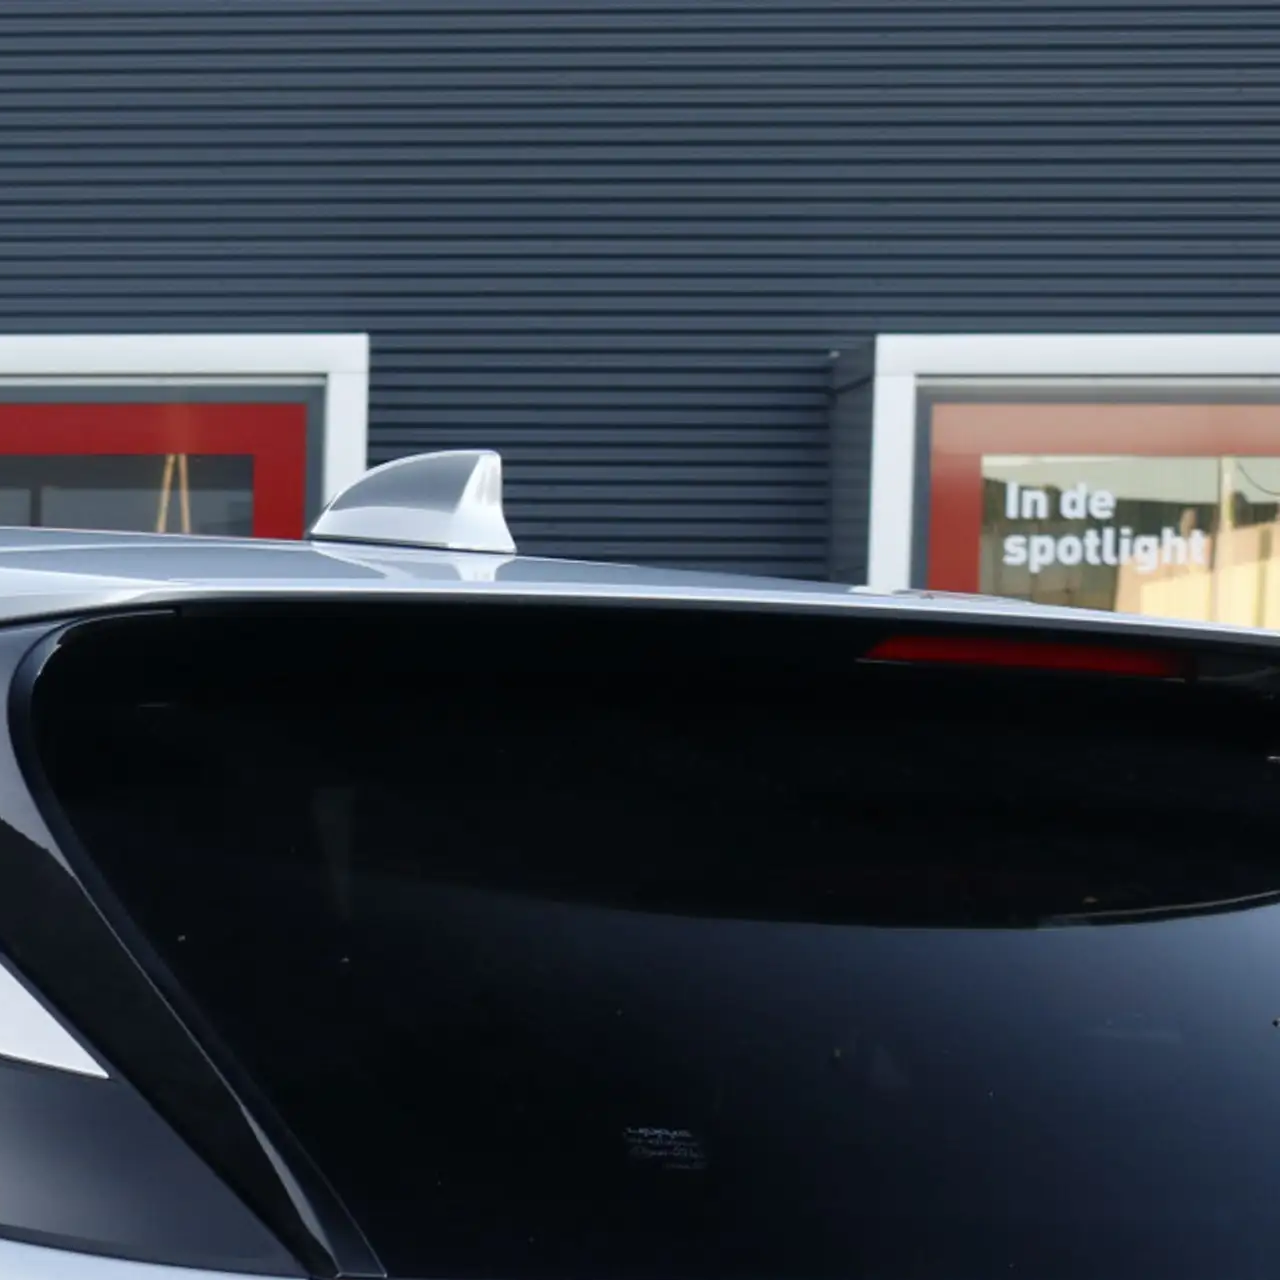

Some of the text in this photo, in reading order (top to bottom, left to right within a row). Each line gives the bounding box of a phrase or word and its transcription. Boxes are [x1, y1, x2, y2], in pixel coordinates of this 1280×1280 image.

[1005, 481, 1116, 519] In de
[1002, 527, 1206, 573] spotlight
